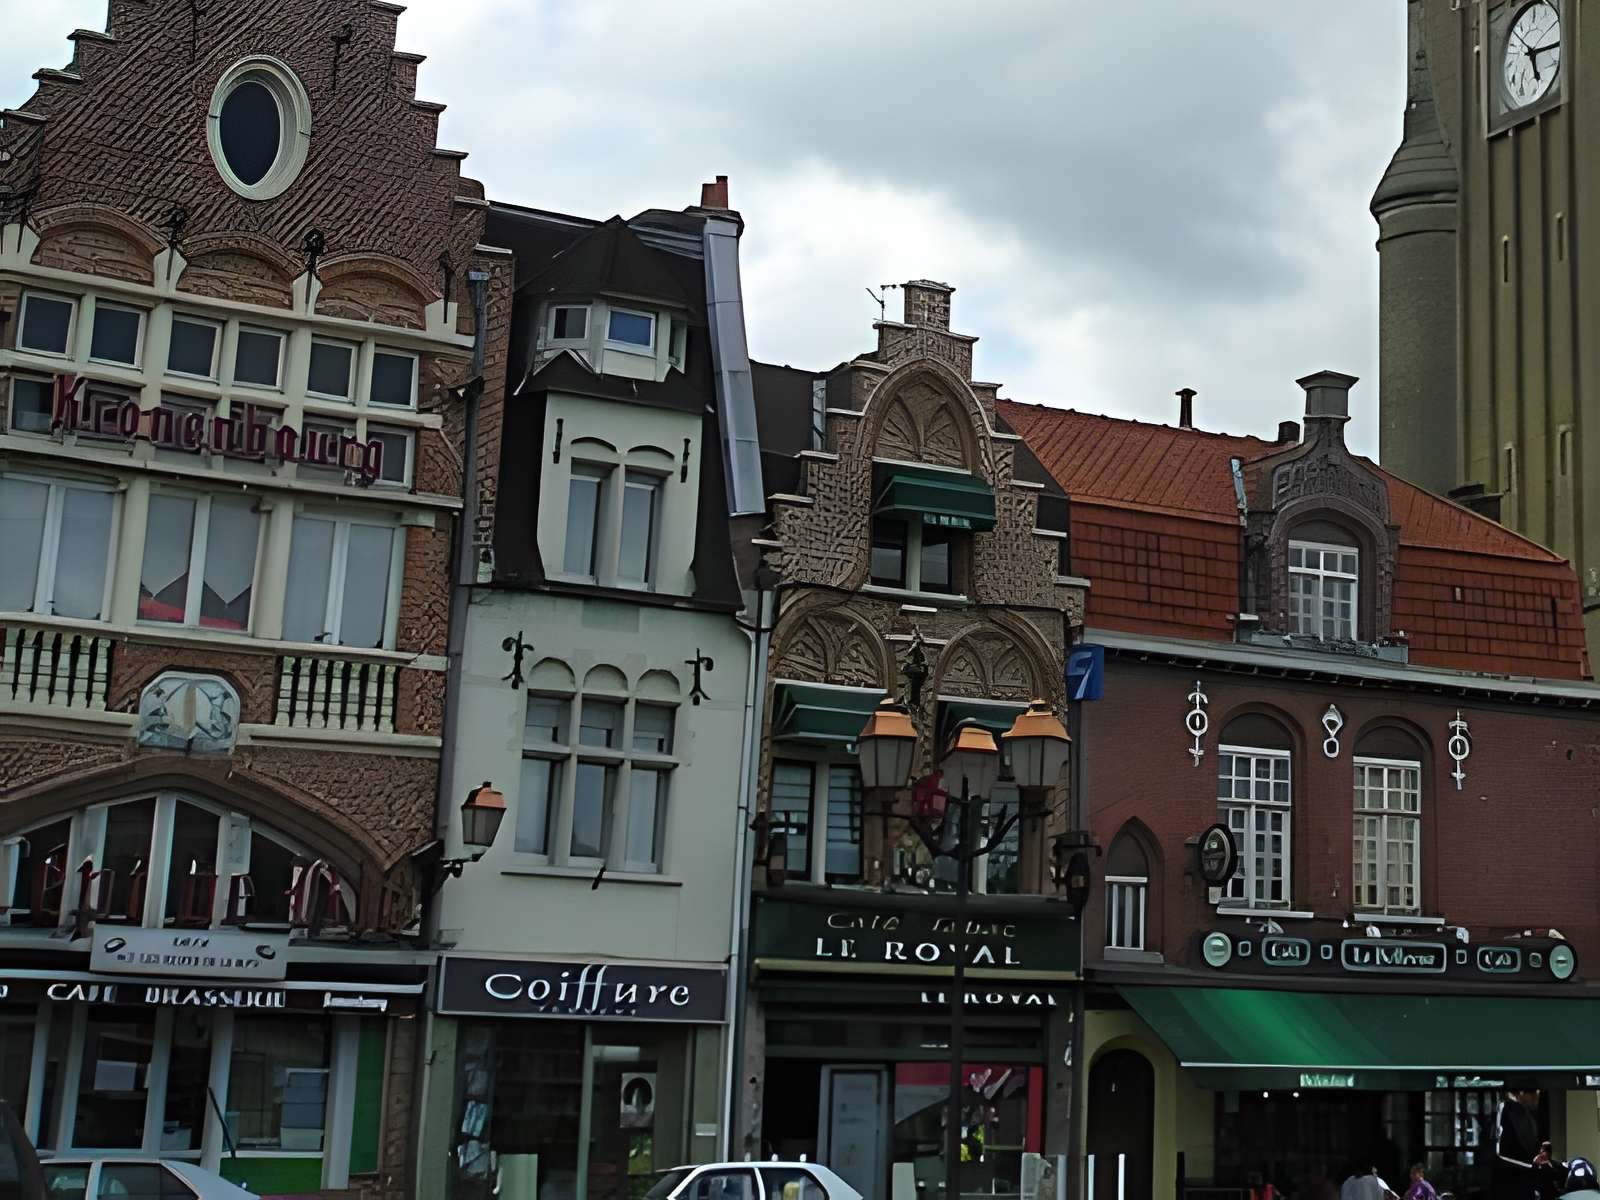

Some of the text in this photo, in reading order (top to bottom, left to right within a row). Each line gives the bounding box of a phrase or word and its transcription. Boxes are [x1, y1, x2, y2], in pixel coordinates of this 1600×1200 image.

[52, 374, 384, 487] Kronenbourg
[815, 937, 857, 959] LE
[485, 964, 690, 1013] Coiffure
